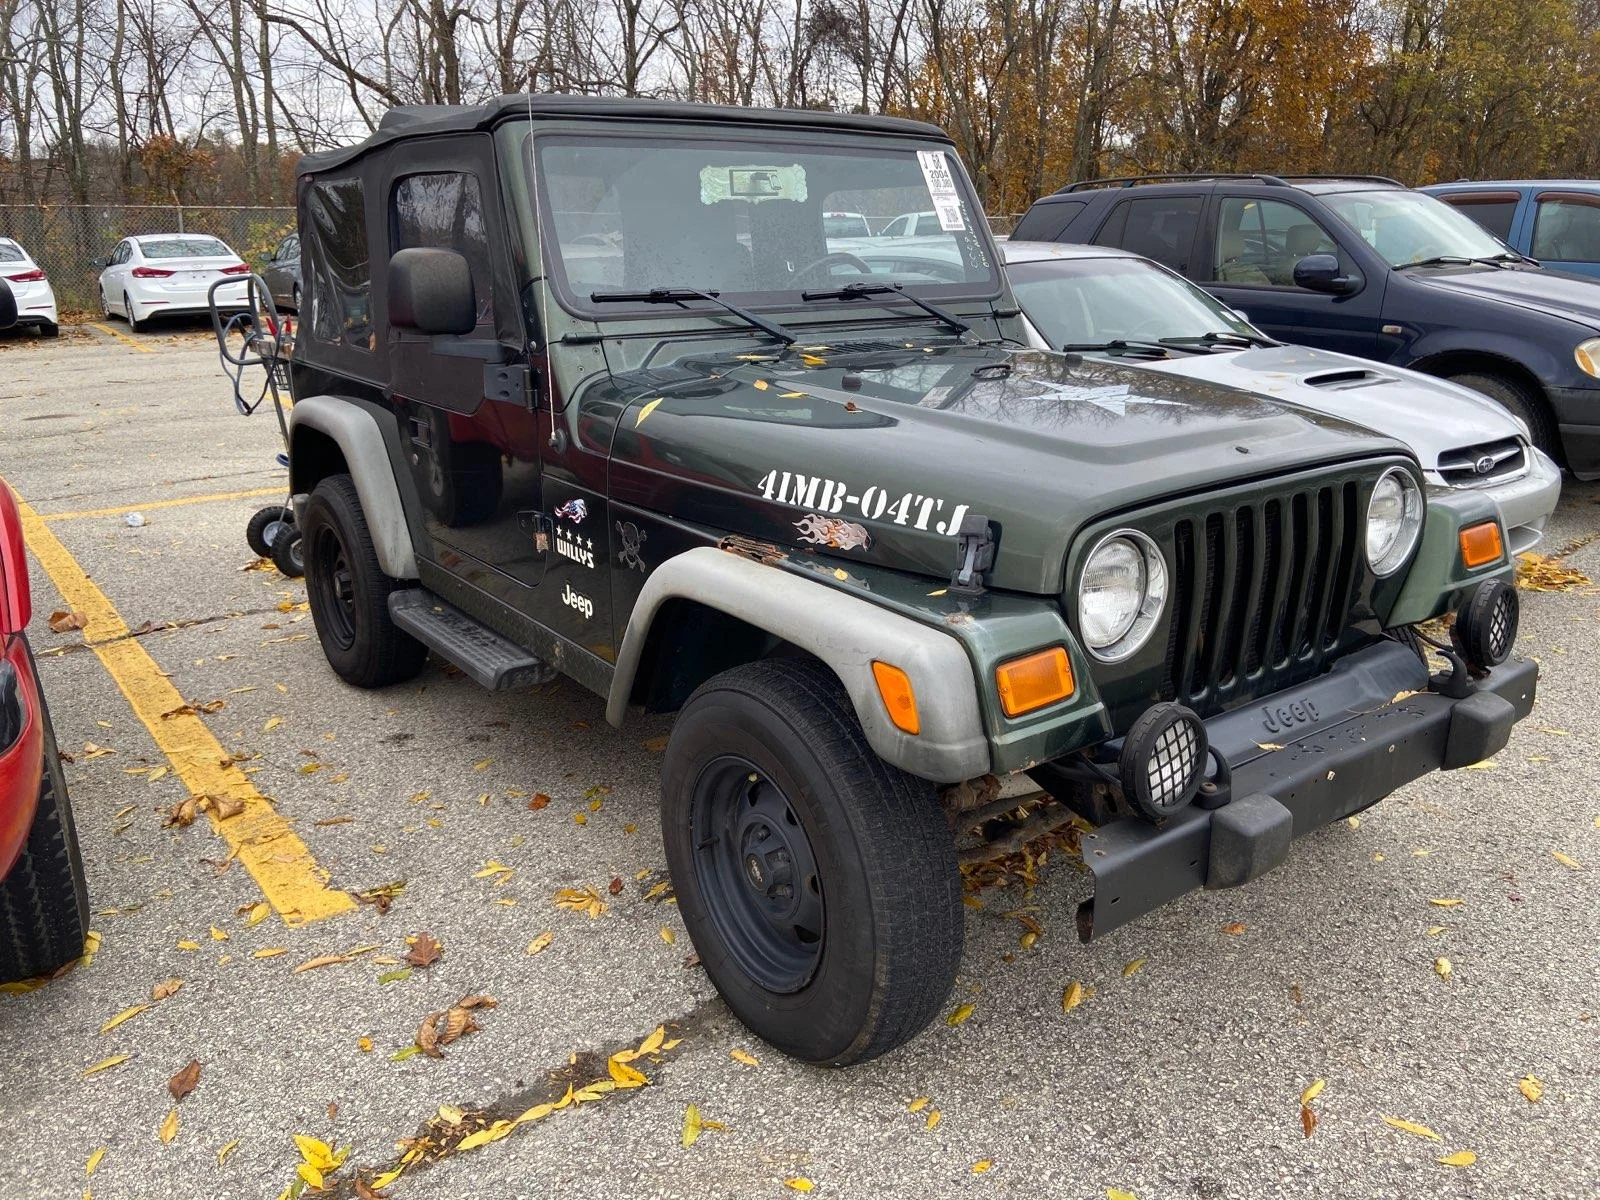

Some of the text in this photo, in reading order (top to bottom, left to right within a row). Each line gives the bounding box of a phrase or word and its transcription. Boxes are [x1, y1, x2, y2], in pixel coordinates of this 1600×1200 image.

[929, 169, 949, 179] 2004
[556, 537, 595, 569] WILLYS
[561, 584, 594, 619] Jeep
[1261, 697, 1320, 734] Jeep
